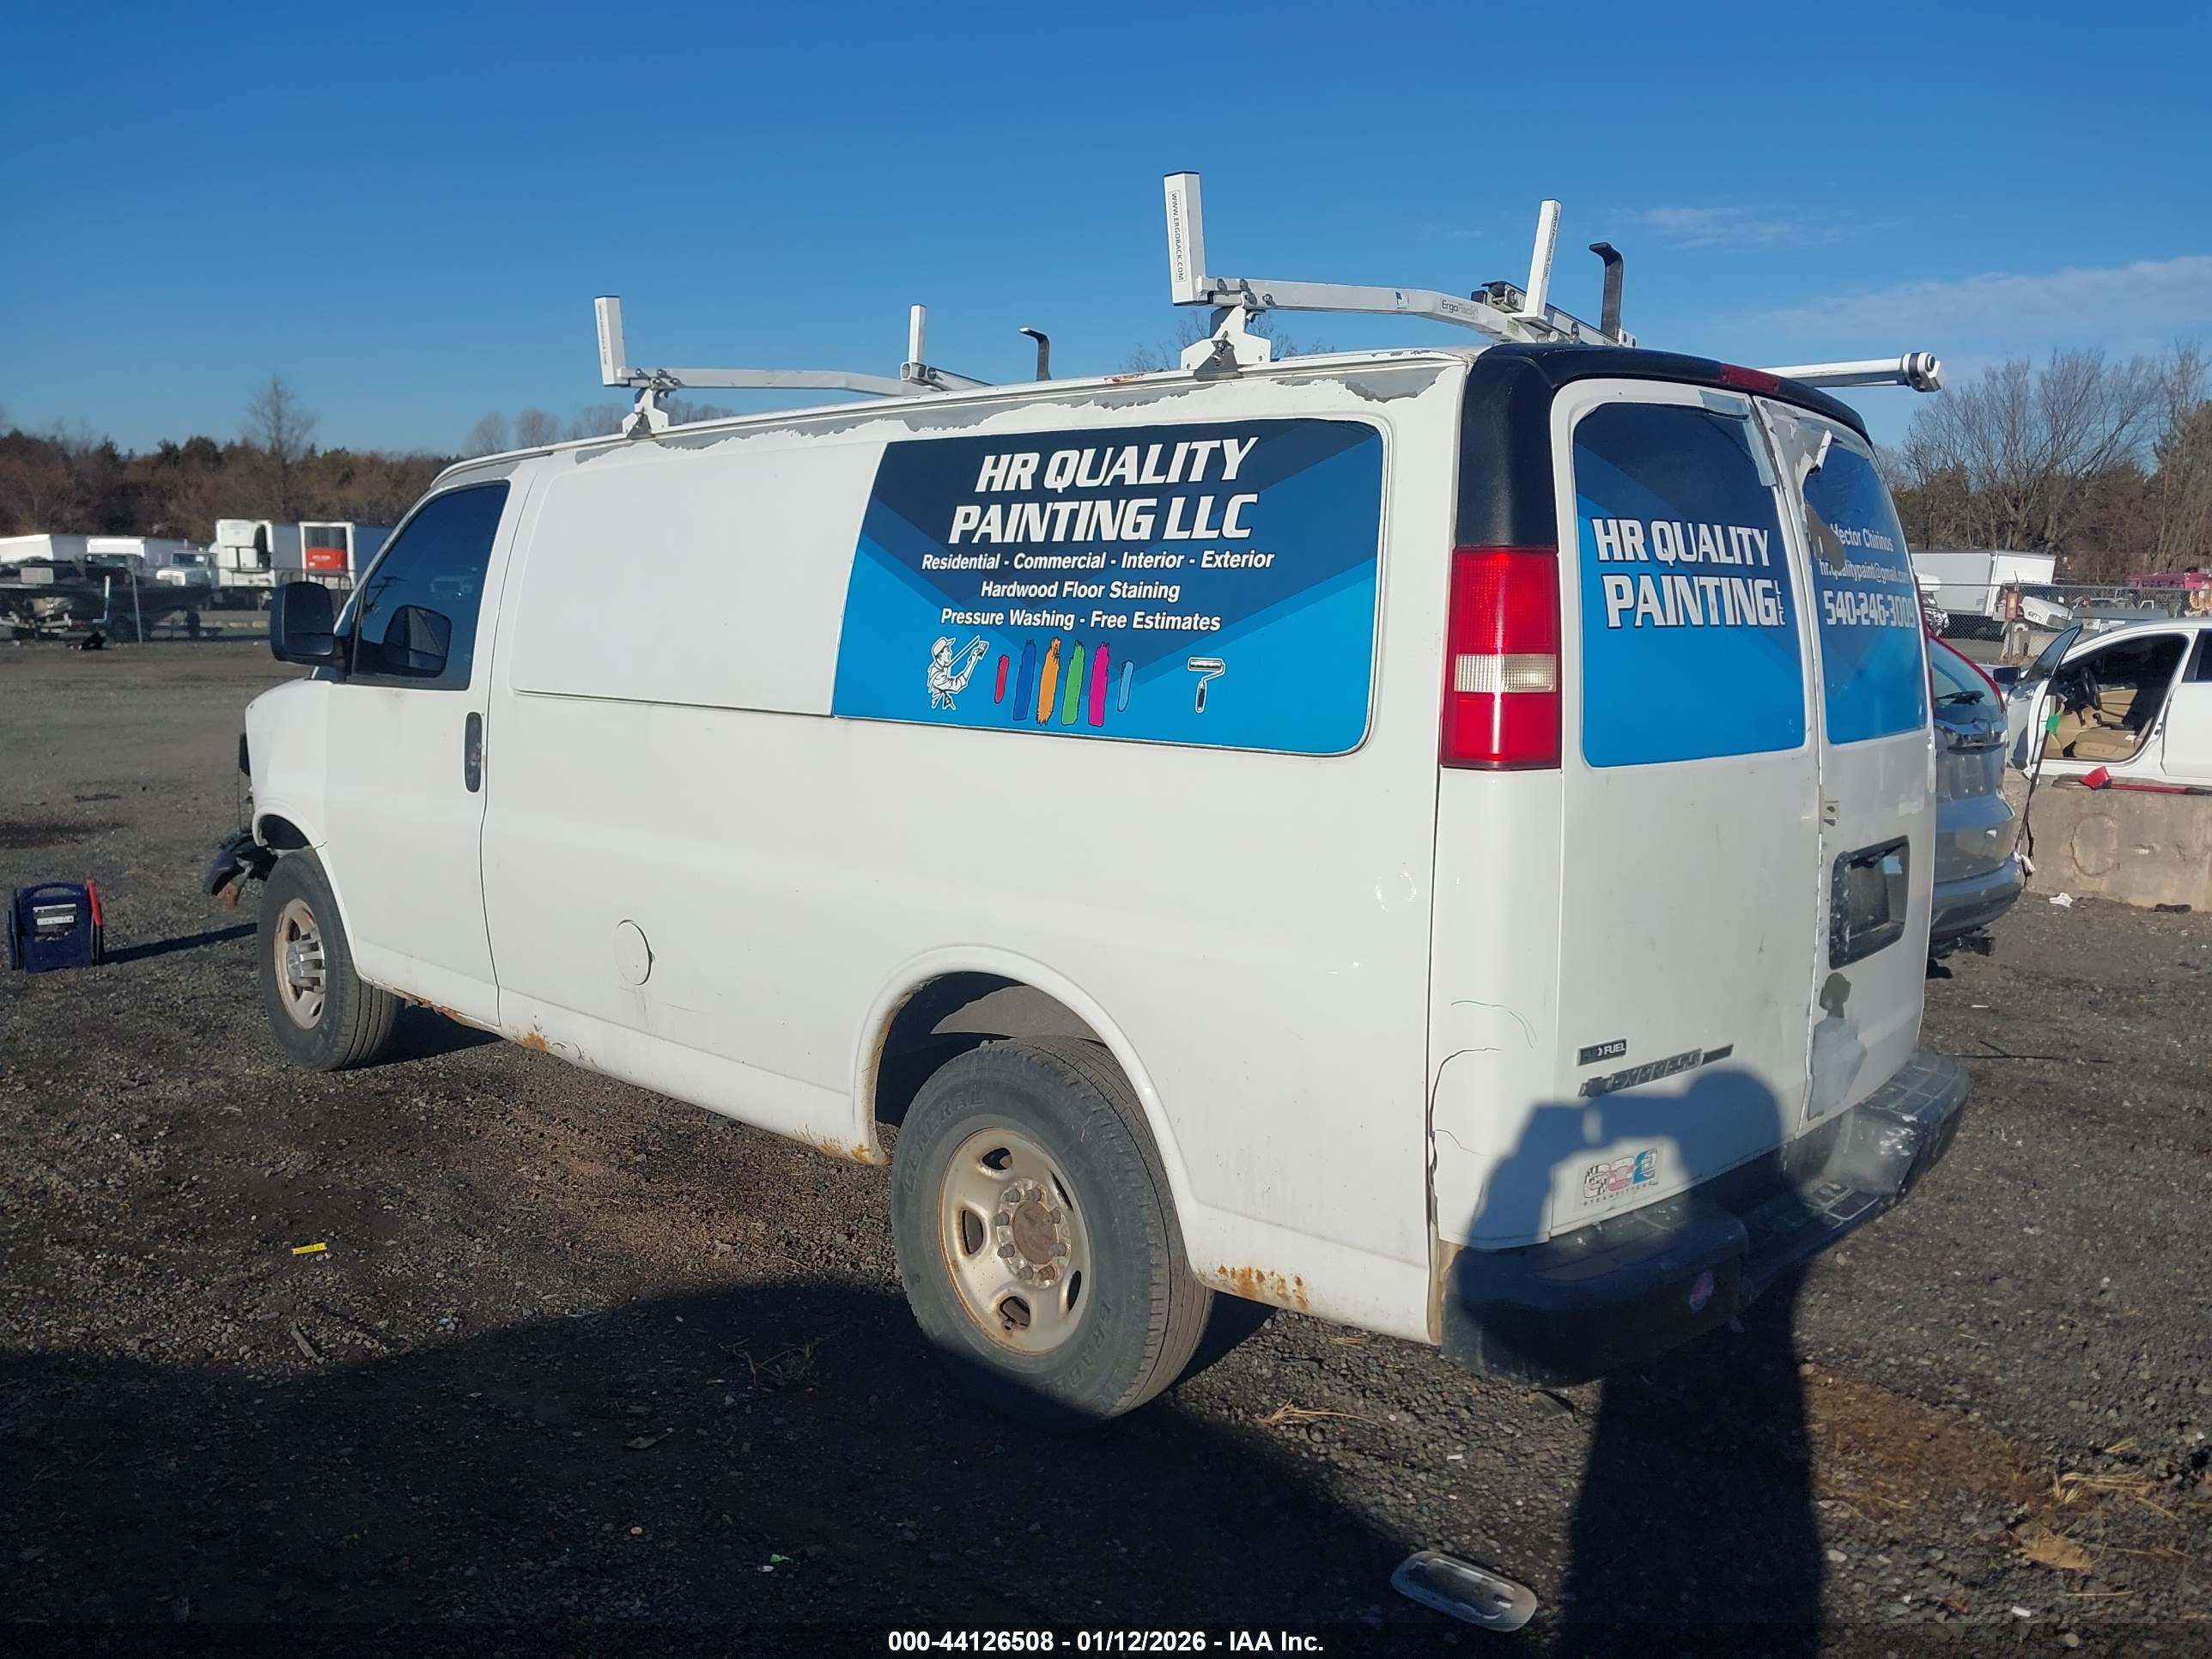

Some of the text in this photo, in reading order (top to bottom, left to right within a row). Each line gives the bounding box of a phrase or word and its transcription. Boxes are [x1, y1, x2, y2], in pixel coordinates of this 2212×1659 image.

[1171, 192, 1184, 281] WWW.ERGORACK.COM
[975, 436, 1260, 494] HR QUALITY
[947, 493, 1259, 544] PAINTING LLC
[1863, 527, 1894, 552] Chirinos
[921, 553, 1001, 570] Residential
[1013, 551, 1107, 570] Commercial
[1121, 550, 1185, 569] Interior
[1200, 550, 1275, 568] Exterior
[1591, 519, 1771, 567] HR QUALITY
[981, 580, 1181, 603] Hardwood Floor Staining
[1601, 574, 1779, 628] PAINTING
[1774, 579, 1786, 626] LLC
[1823, 590, 1917, 629] 540-246-3009
[940, 607, 1005, 626] Pressure
[1009, 609, 1075, 631] Washing
[1090, 610, 1127, 629] Free
[1132, 611, 1222, 631] Estimates
